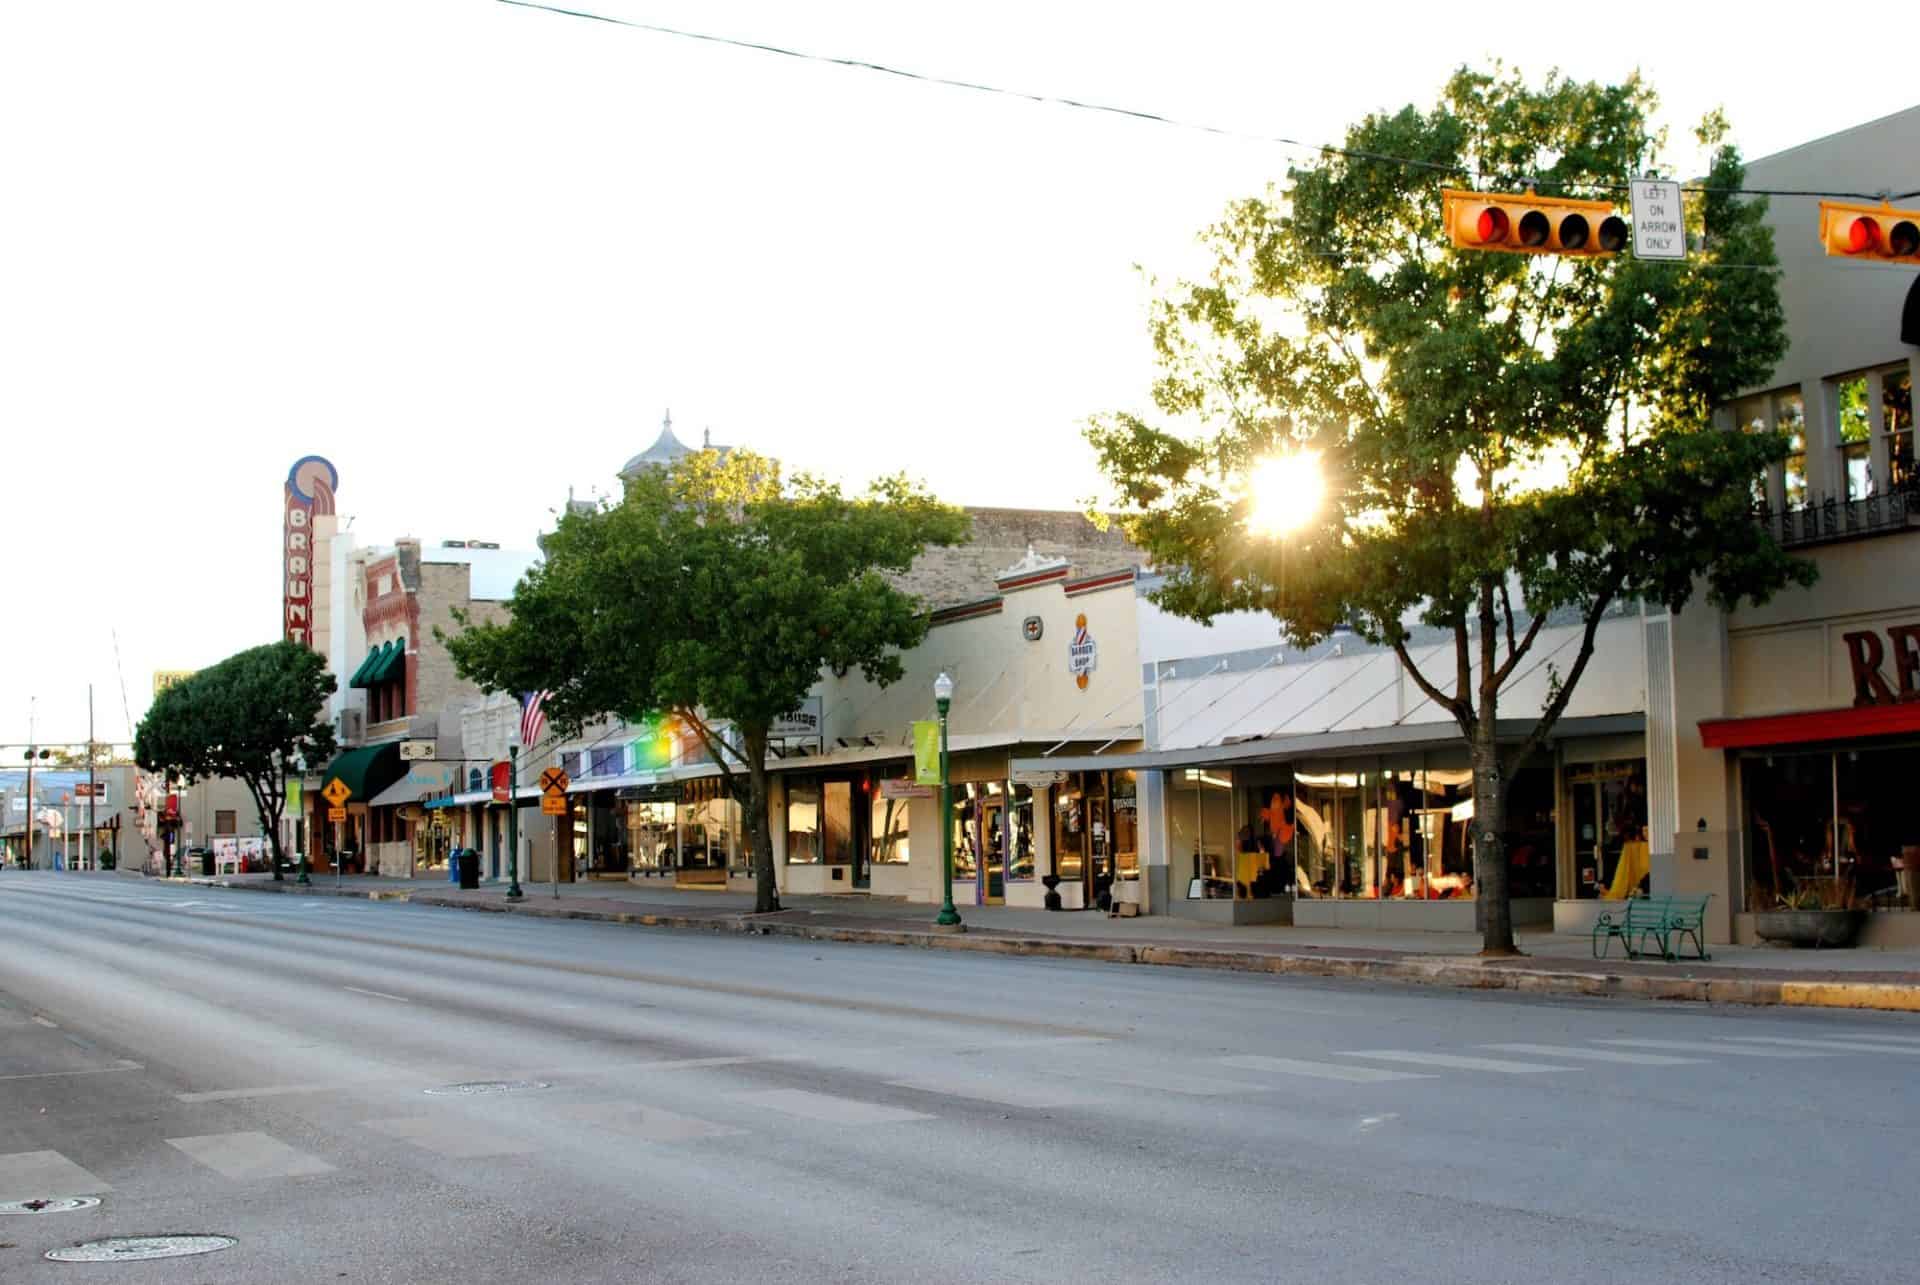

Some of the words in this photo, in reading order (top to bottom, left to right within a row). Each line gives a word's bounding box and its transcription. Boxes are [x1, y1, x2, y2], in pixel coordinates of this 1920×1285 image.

[1643, 187, 1667, 199] LEFT
[1649, 204, 1664, 216] ON
[1641, 221, 1677, 232] ARROW
[1646, 238, 1672, 249] ONLY
[1071, 645, 1092, 656] BARBER
[1074, 656, 1090, 667] SHOP
